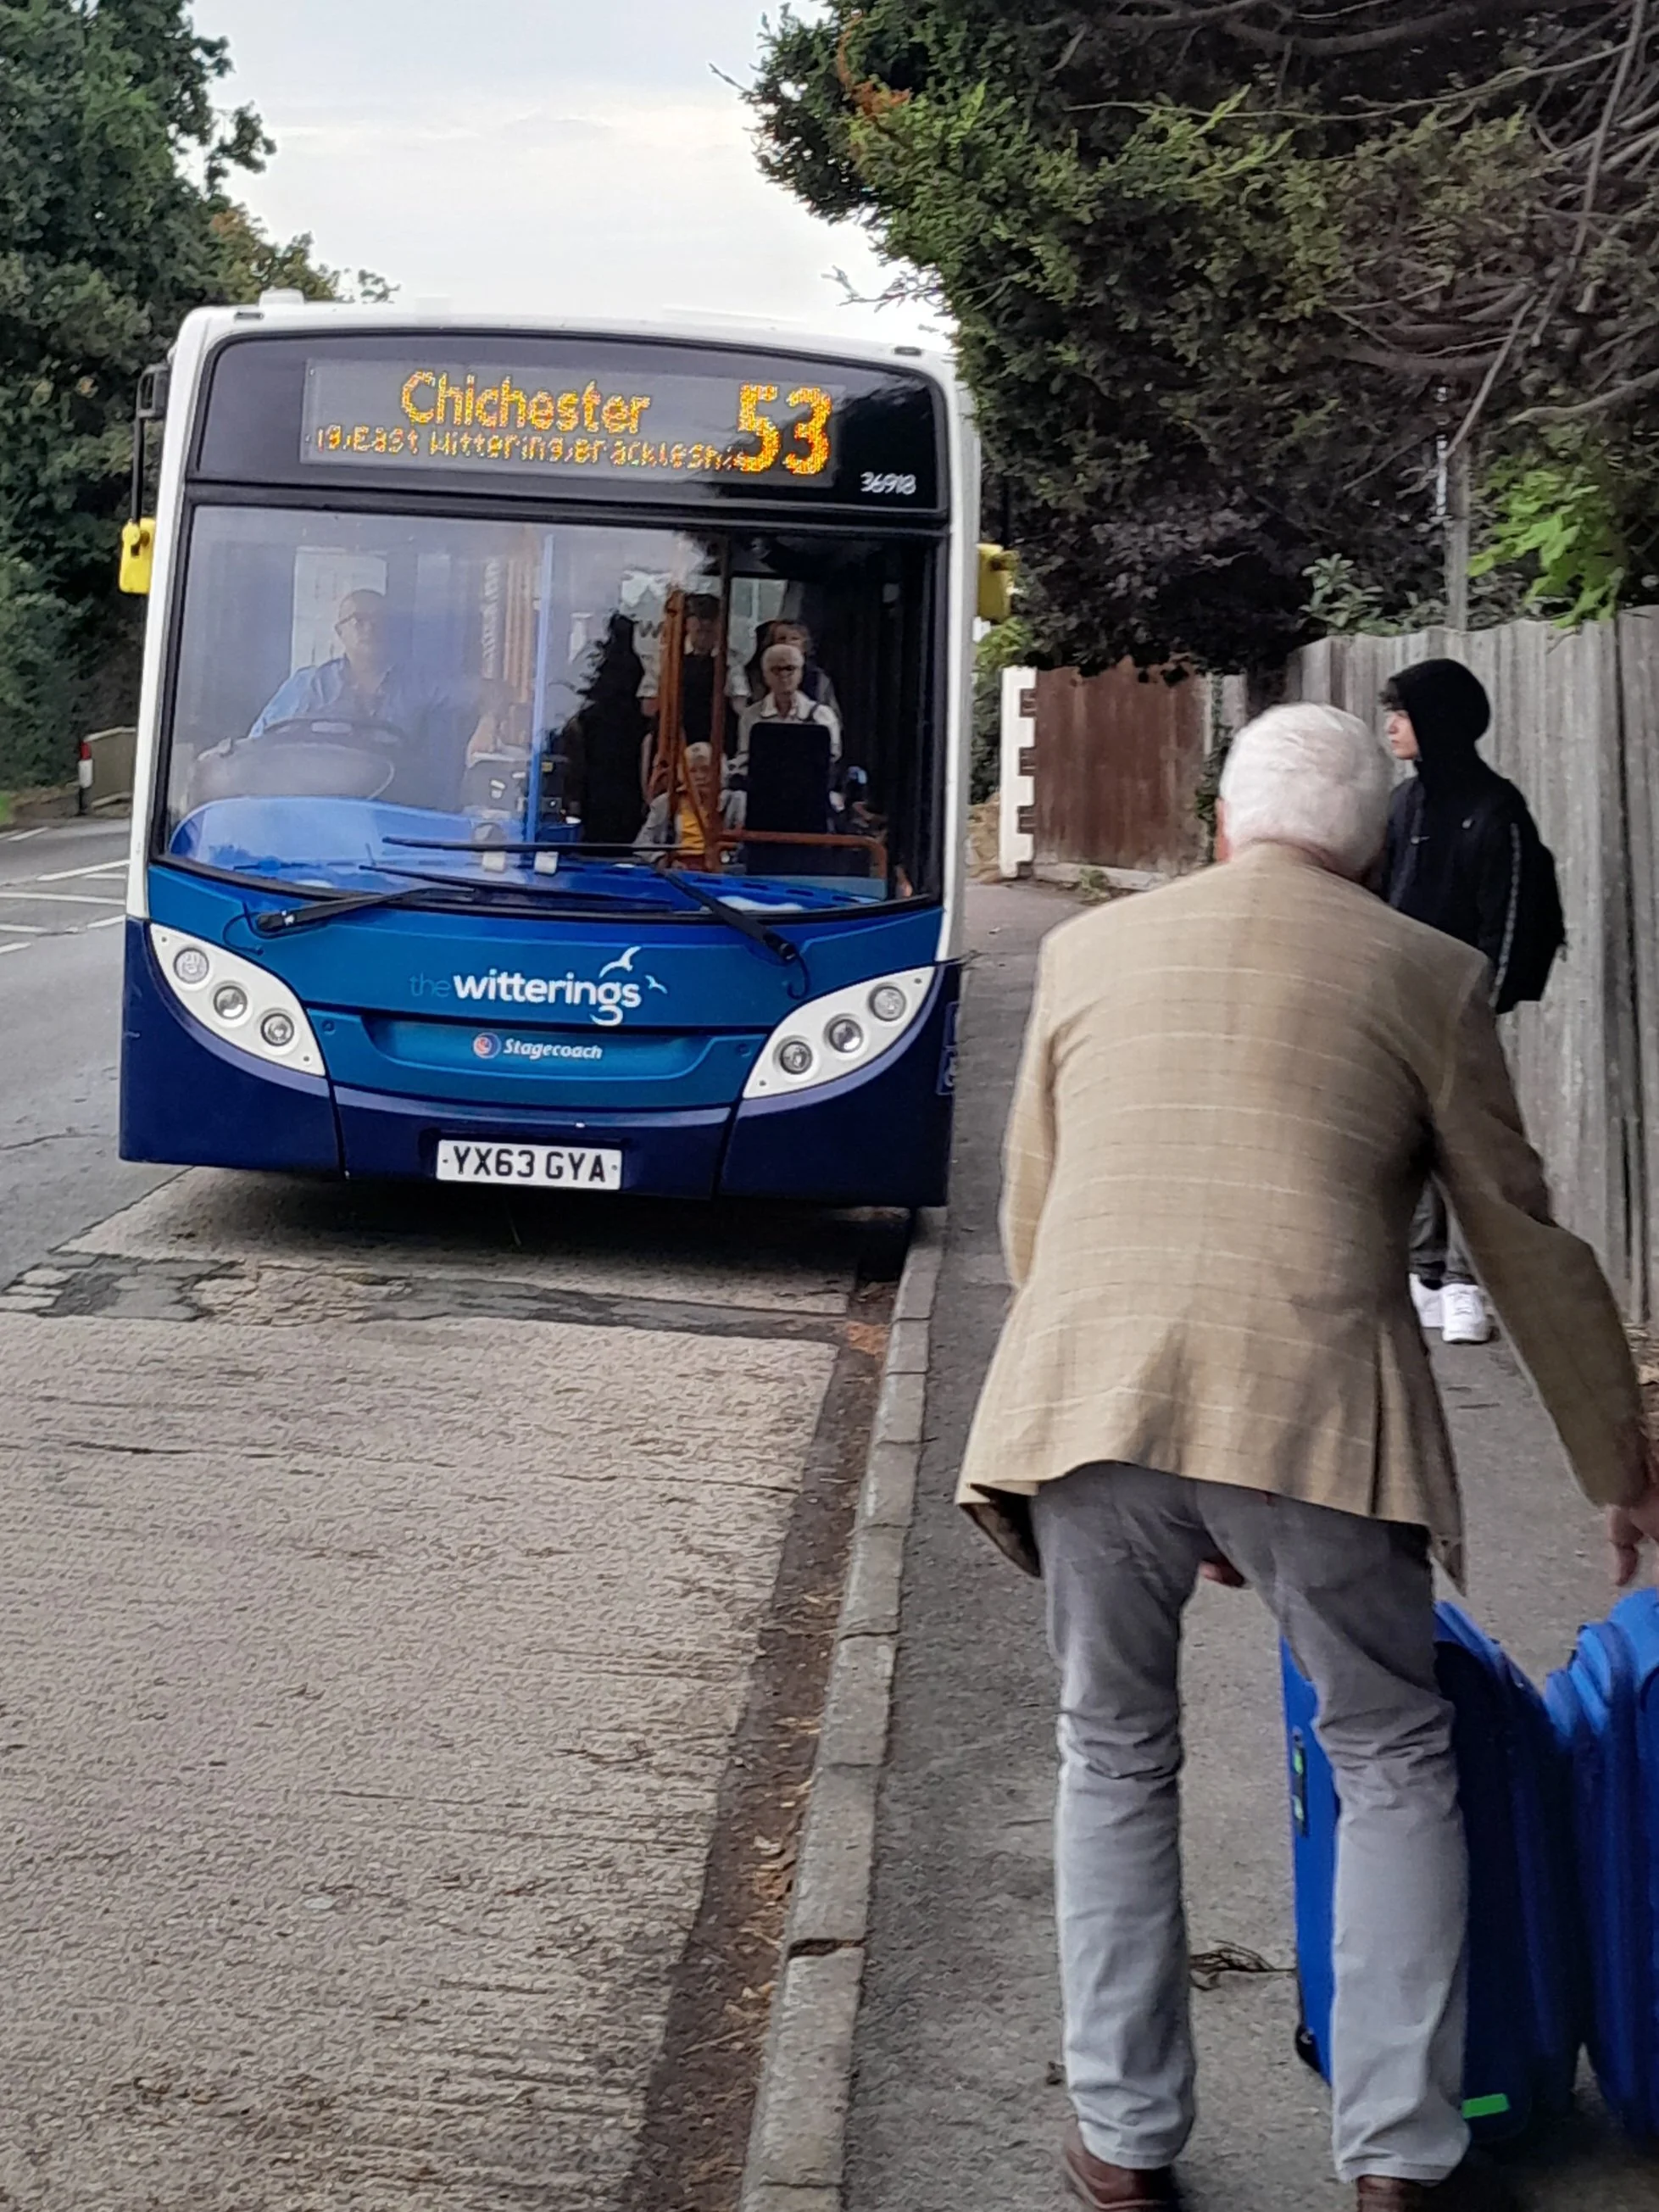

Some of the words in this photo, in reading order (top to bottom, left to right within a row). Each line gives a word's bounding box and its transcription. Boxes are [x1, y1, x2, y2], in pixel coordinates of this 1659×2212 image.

[401, 371, 650, 432] Chichester
[738, 382, 832, 474] 53
[860, 471, 916, 495] 36918
[411, 972, 451, 997] the
[454, 969, 642, 1026] witterings
[503, 1039, 603, 1060] Stagecoach
[454, 1145, 536, 1177] YX63
[545, 1151, 605, 1183] GYA
